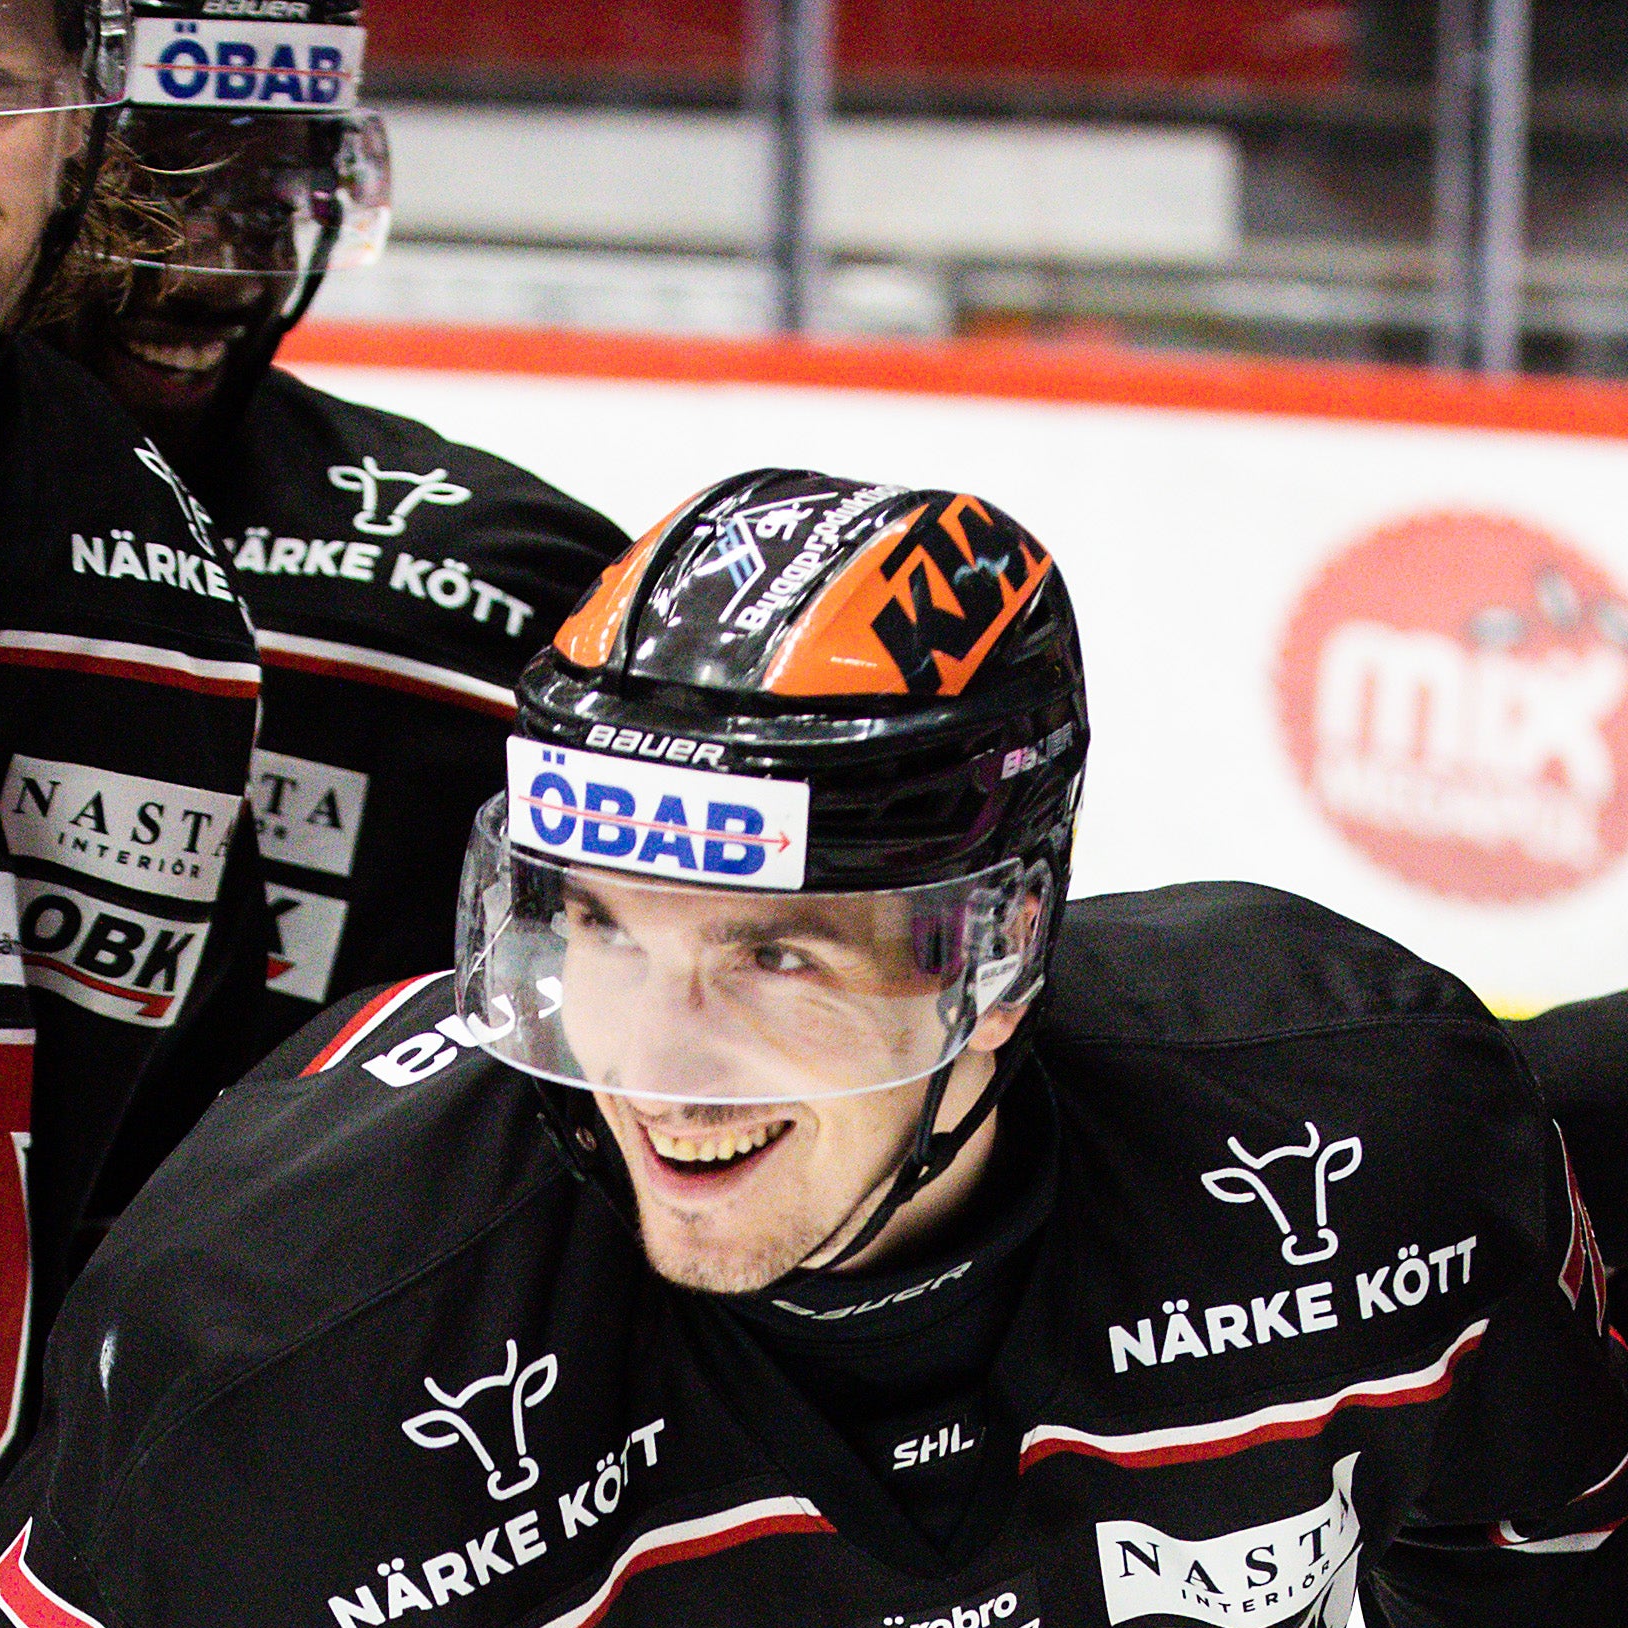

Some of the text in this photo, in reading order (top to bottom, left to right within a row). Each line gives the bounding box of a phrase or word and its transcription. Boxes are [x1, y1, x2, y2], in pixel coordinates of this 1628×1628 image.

[156, 22, 344, 104] ÖBAB
[72, 529, 236, 602] NÄRKE
[223, 527, 534, 638] ÄRKE KÖTT
[871, 491, 1052, 696] KTM
[585, 723, 728, 770] BAUER
[13, 776, 229, 857] NAST
[528, 750, 768, 877] ÖBAB
[21, 893, 196, 992] OBK
[1109, 1236, 1478, 1374] NÄRKE KÖTT
[559, 1418, 667, 1540] KÖTT
[891, 1424, 976, 1471] SHL
[1115, 1488, 1351, 1597] NASTA
